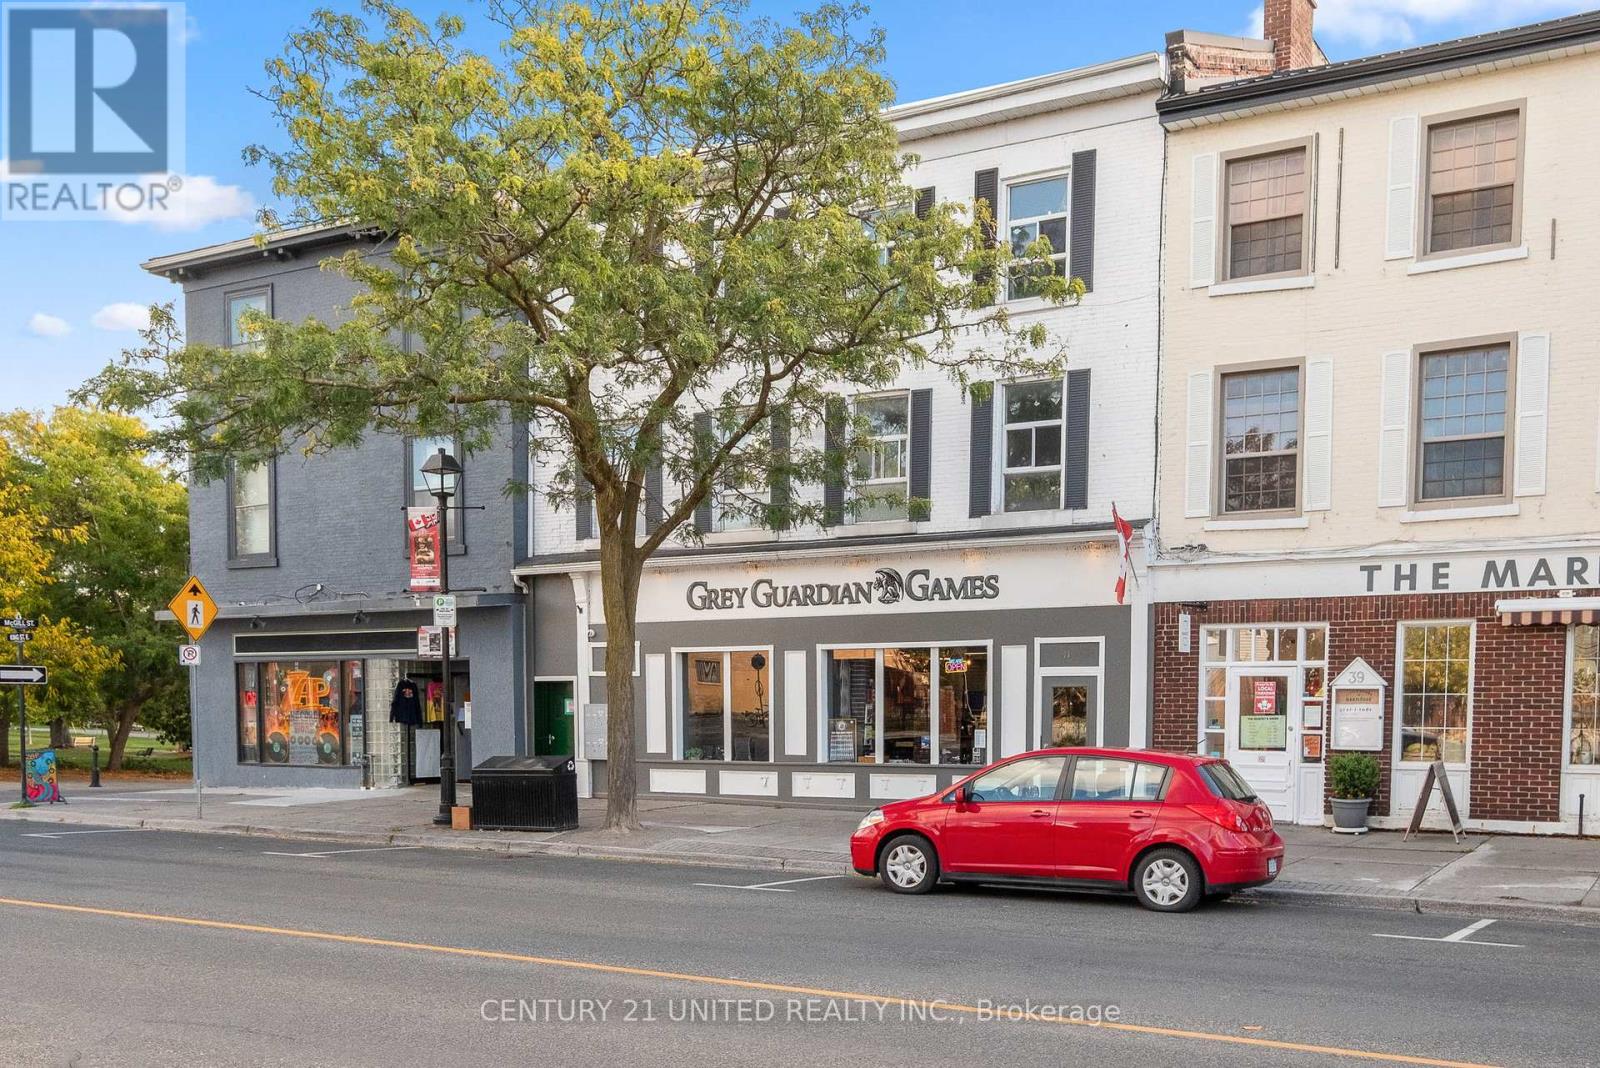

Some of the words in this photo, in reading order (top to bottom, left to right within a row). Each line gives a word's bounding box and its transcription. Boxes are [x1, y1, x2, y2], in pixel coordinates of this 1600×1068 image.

[1359, 562, 1450, 592] THE
[1481, 556, 1600, 588] MAR
[686, 581, 749, 610] GREY
[750, 578, 874, 608] GUARDIAN
[904, 568, 999, 601] GAMES
[946, 662, 967, 670] OPEN
[1348, 670, 1365, 684] 39
